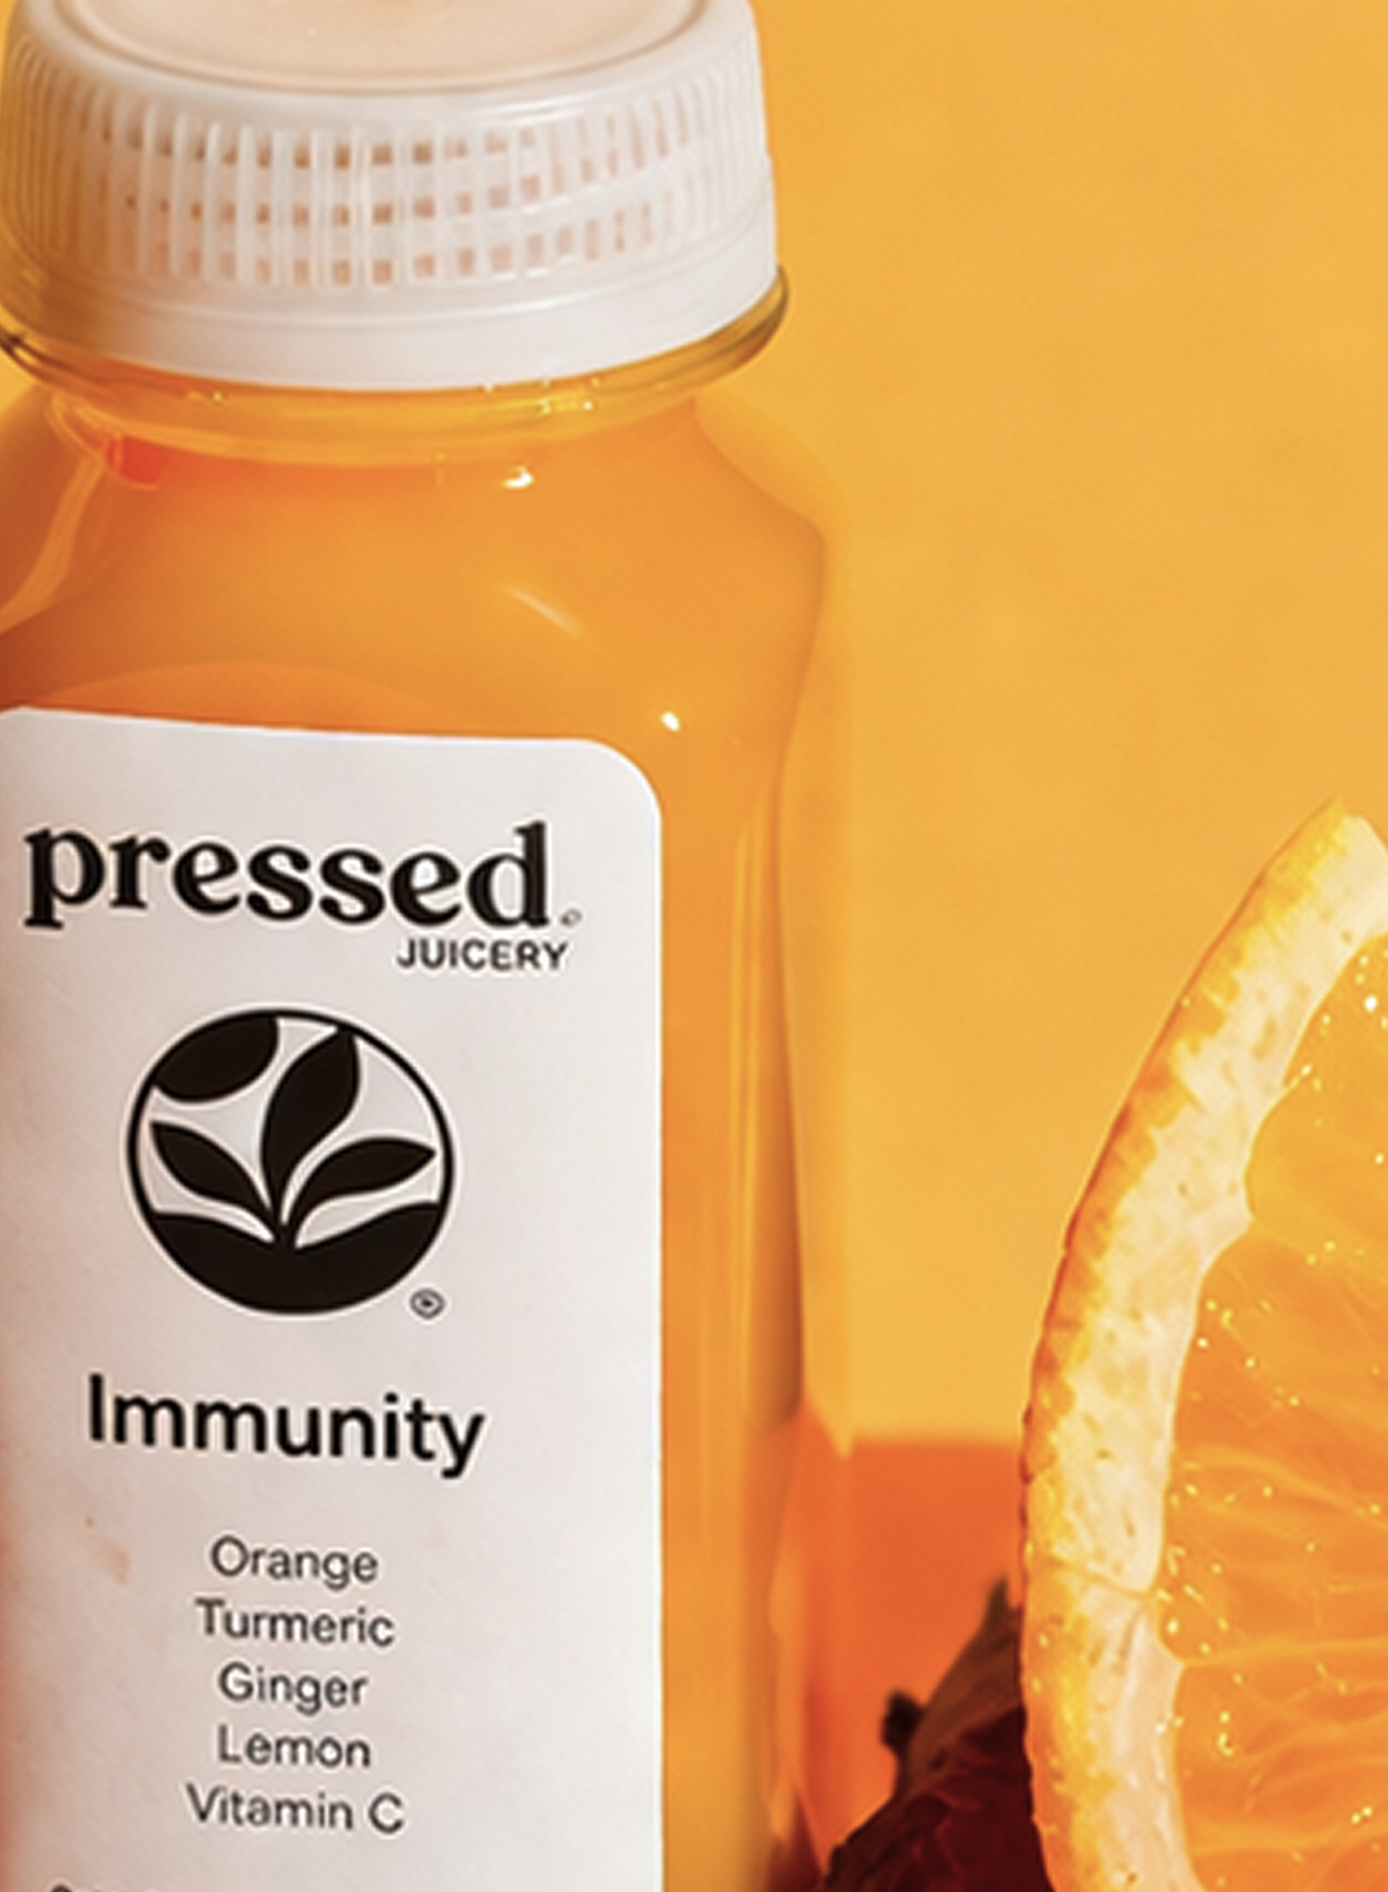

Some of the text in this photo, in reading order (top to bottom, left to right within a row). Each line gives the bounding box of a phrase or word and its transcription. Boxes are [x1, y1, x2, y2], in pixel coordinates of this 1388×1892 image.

[22, 819, 552, 931] pressed
[396, 936, 570, 974] JUICERY
[87, 1371, 487, 1480] Immunity
[210, 1534, 380, 1591] Orange
[193, 1596, 396, 1649] Turmeric
[216, 1659, 369, 1717] Ginger
[216, 1722, 372, 1771] Lemon
[185, 1782, 406, 1835] Vitamin C
